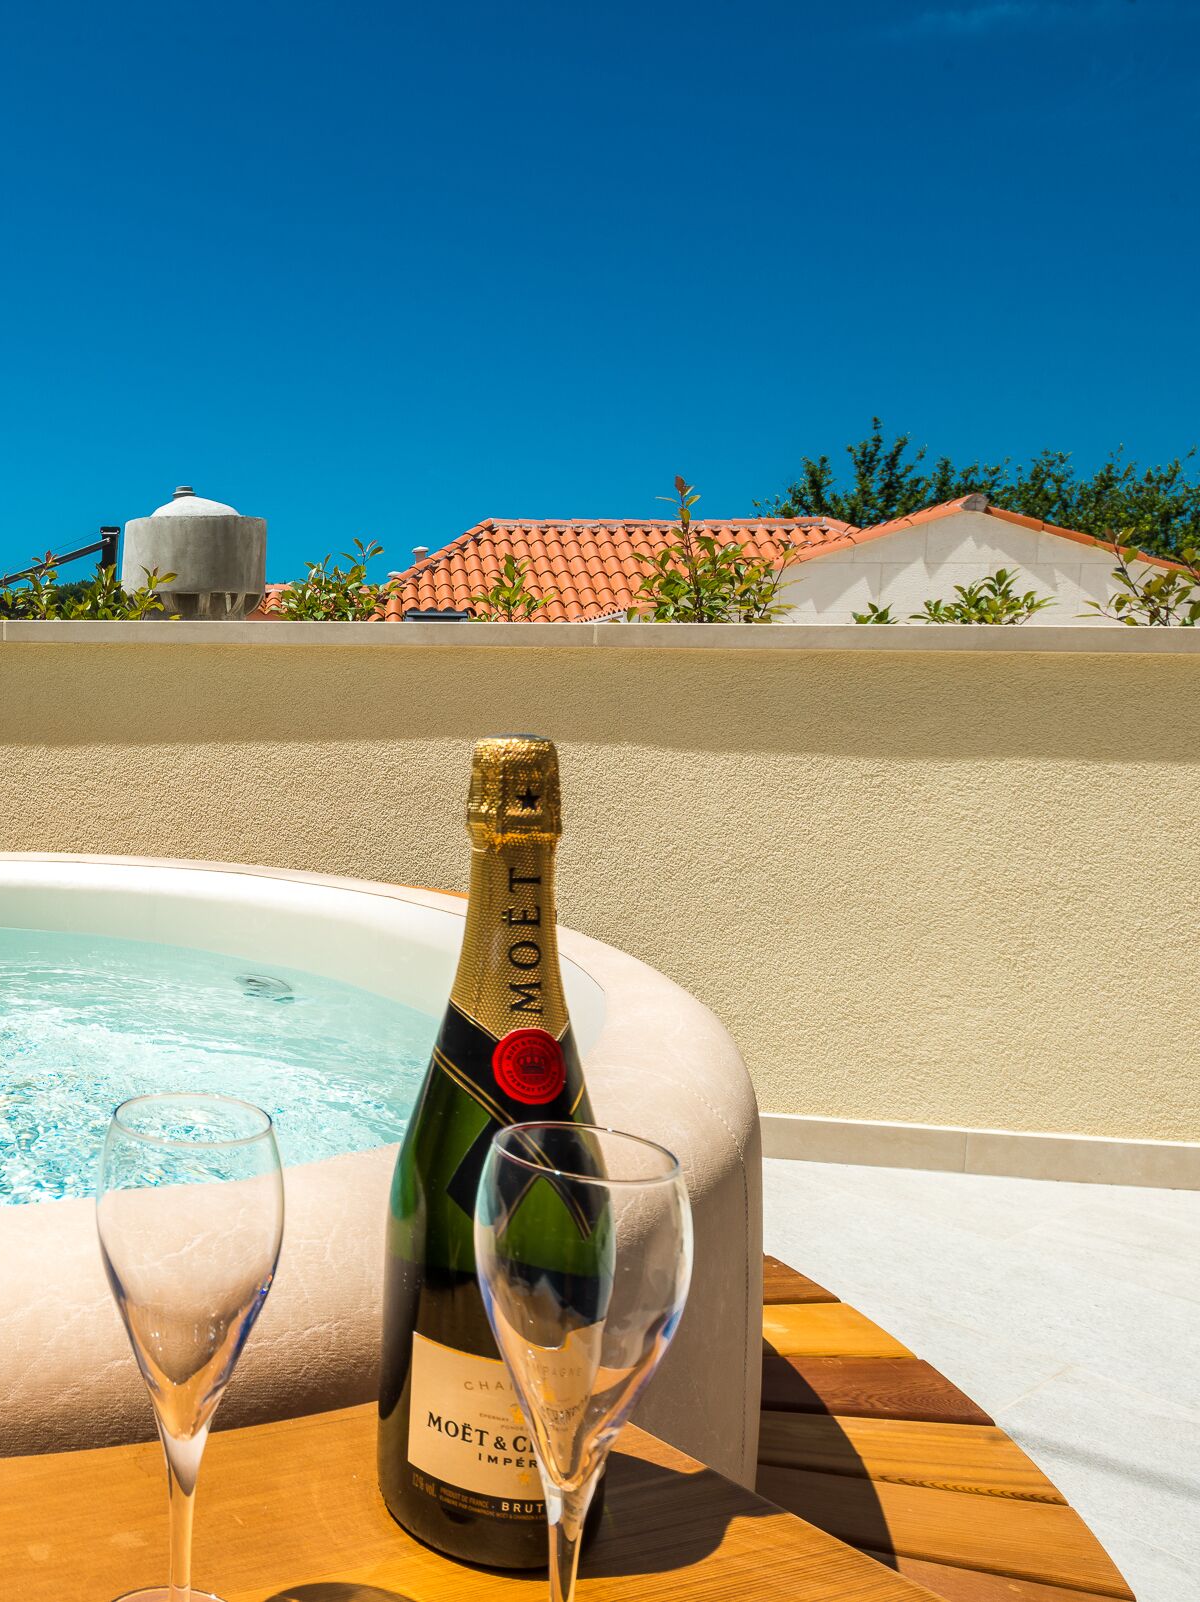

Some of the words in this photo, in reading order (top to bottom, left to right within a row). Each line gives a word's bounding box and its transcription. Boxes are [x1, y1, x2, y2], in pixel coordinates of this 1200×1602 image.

[502, 867, 542, 1014] MOËT
[427, 1411, 489, 1447] MOËT
[494, 1436, 507, 1451] &
[501, 1501, 544, 1514] BRUT
